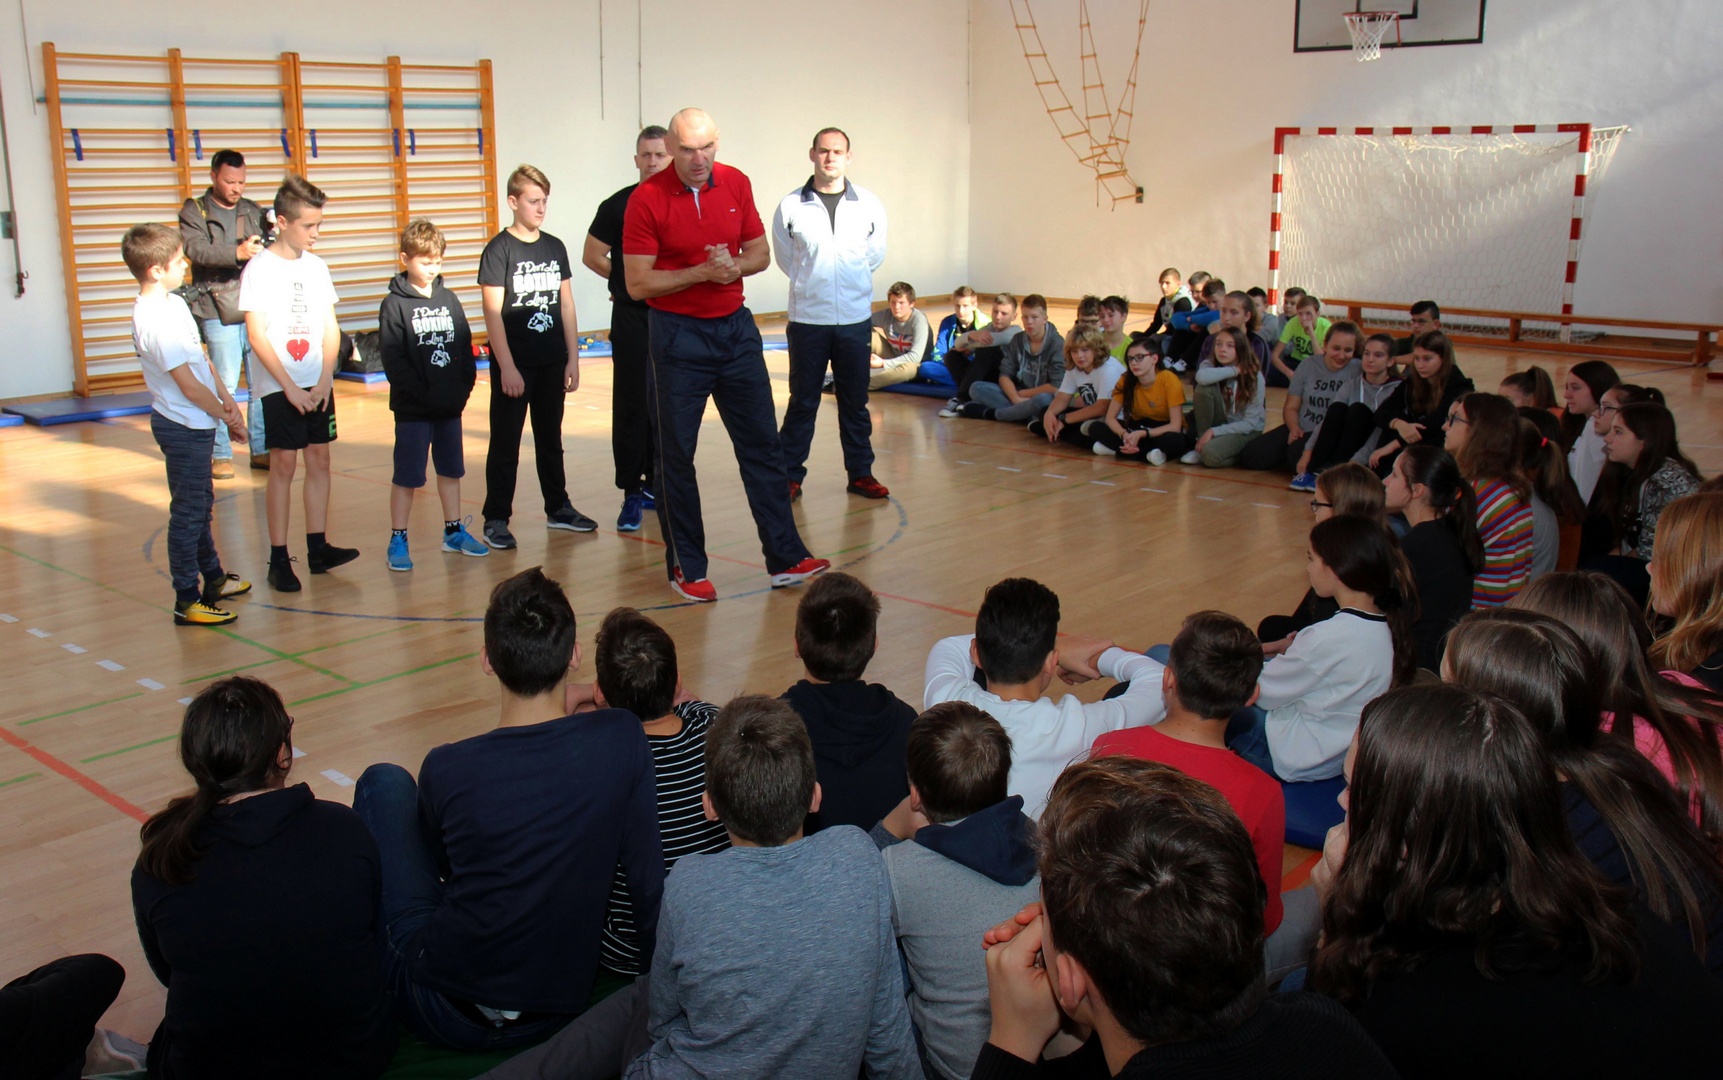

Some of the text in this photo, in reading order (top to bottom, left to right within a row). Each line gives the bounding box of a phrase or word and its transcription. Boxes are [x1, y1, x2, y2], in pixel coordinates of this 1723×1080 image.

[514, 262, 525, 274] I
[513, 272, 561, 293] BOXING
[512, 293, 528, 306] I
[525, 291, 548, 306] Love
[412, 308, 420, 319] I
[412, 316, 454, 334] BOXING
[417, 333, 426, 346] I
[425, 331, 444, 345] Love
[1309, 396, 1330, 408] NOT
